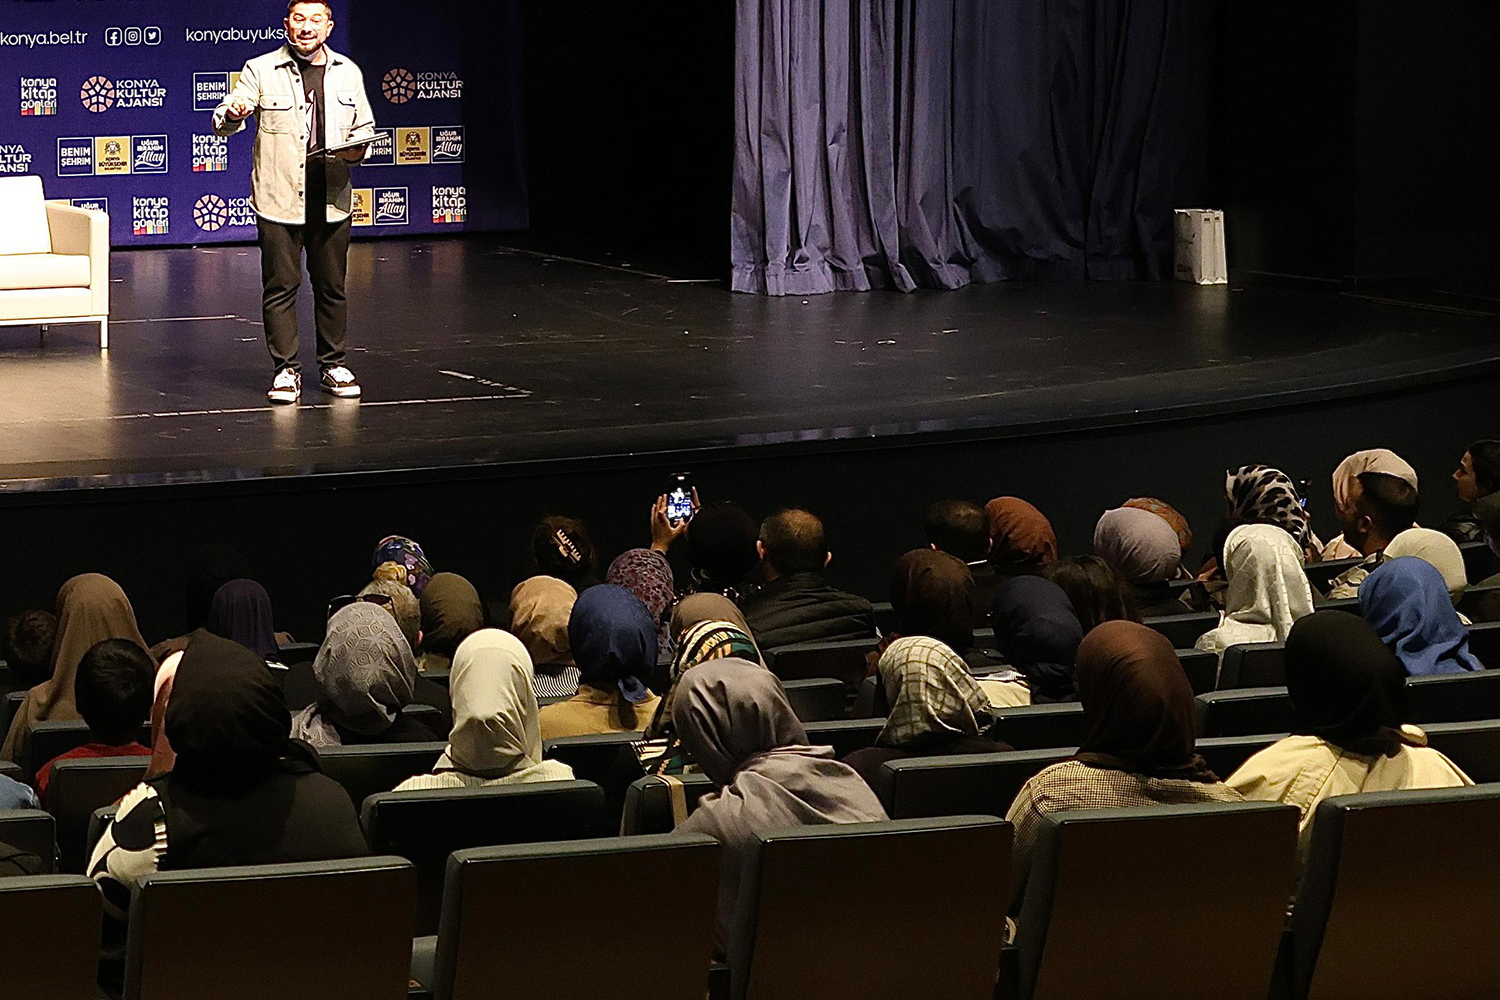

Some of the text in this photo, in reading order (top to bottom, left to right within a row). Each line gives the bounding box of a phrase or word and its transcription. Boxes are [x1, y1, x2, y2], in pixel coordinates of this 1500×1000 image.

[417, 71, 457, 80] KONYA
[21, 77, 56, 88] konya
[116, 79, 160, 88] KONYA
[21, 87, 56, 100] kitap
[417, 89, 461, 98] AJANSI
[116, 97, 163, 108] AJANSI
[193, 144, 227, 156] kitap
[432, 186, 465, 198] konya
[133, 196, 168, 208] konya
[433, 196, 465, 209] kitap
[133, 206, 168, 219] kitap
